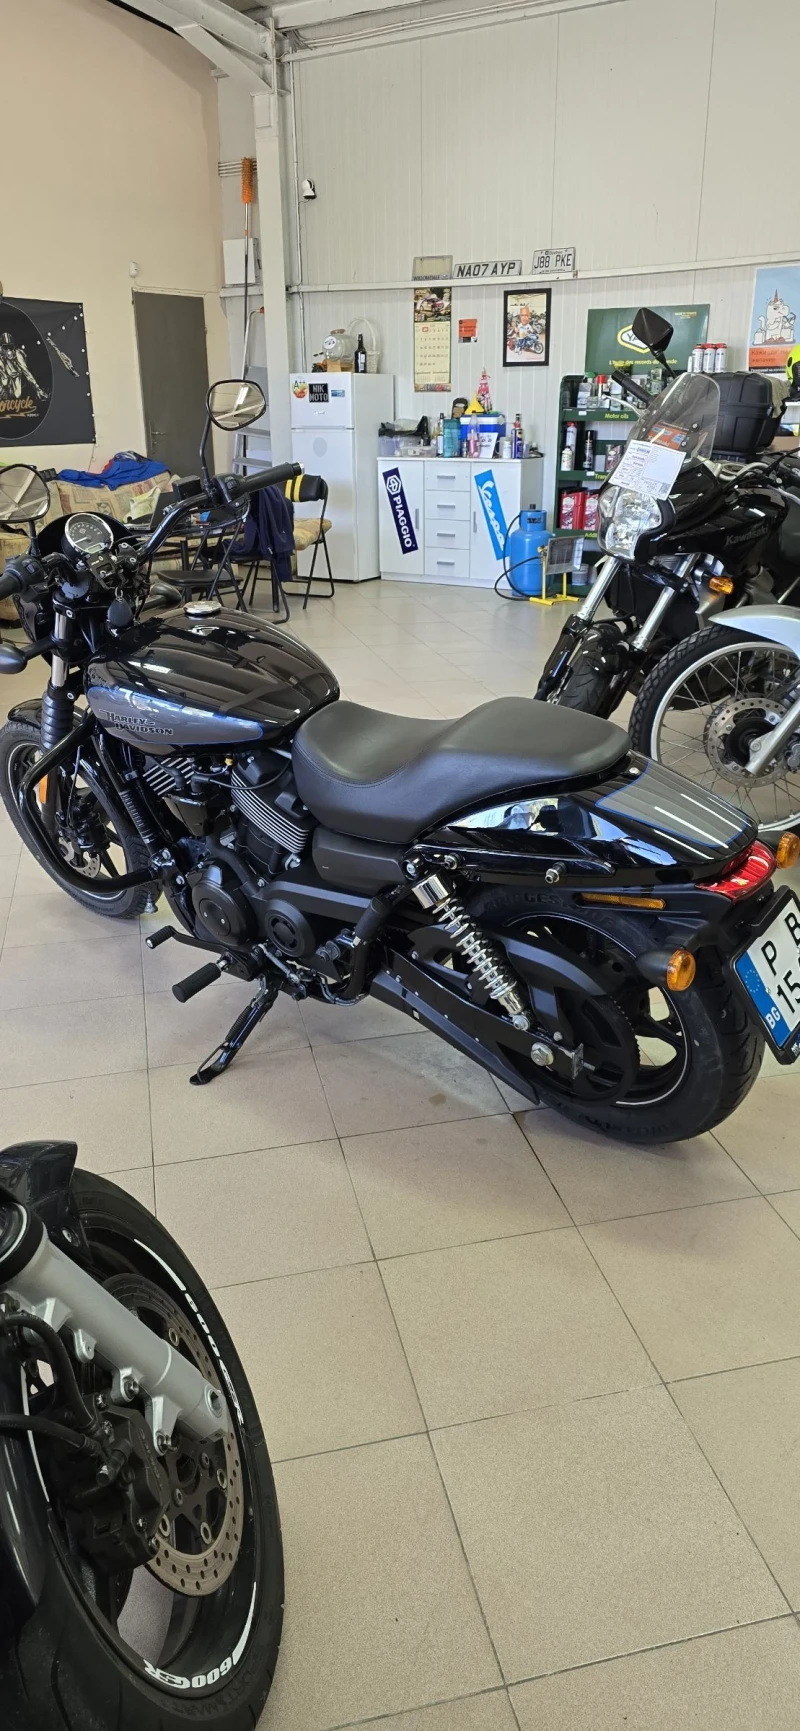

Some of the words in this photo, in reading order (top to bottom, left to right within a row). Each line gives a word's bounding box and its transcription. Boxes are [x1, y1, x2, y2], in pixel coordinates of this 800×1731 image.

[456, 263, 489, 278] NA07
[491, 262, 516, 275] AYP
[534, 256, 550, 269] J88
[555, 253, 572, 267] PKE
[309, 392, 329, 402] MOTO
[312, 384, 325, 393] NIK
[392, 494, 413, 548] PIAGGIO
[478, 479, 505, 551] Vespa
[725, 523, 769, 547] Kawasaki
[115, 722, 173, 735] DAVIDSON
[761, 940, 777, 977] P
[764, 1005, 781, 1030] BG
